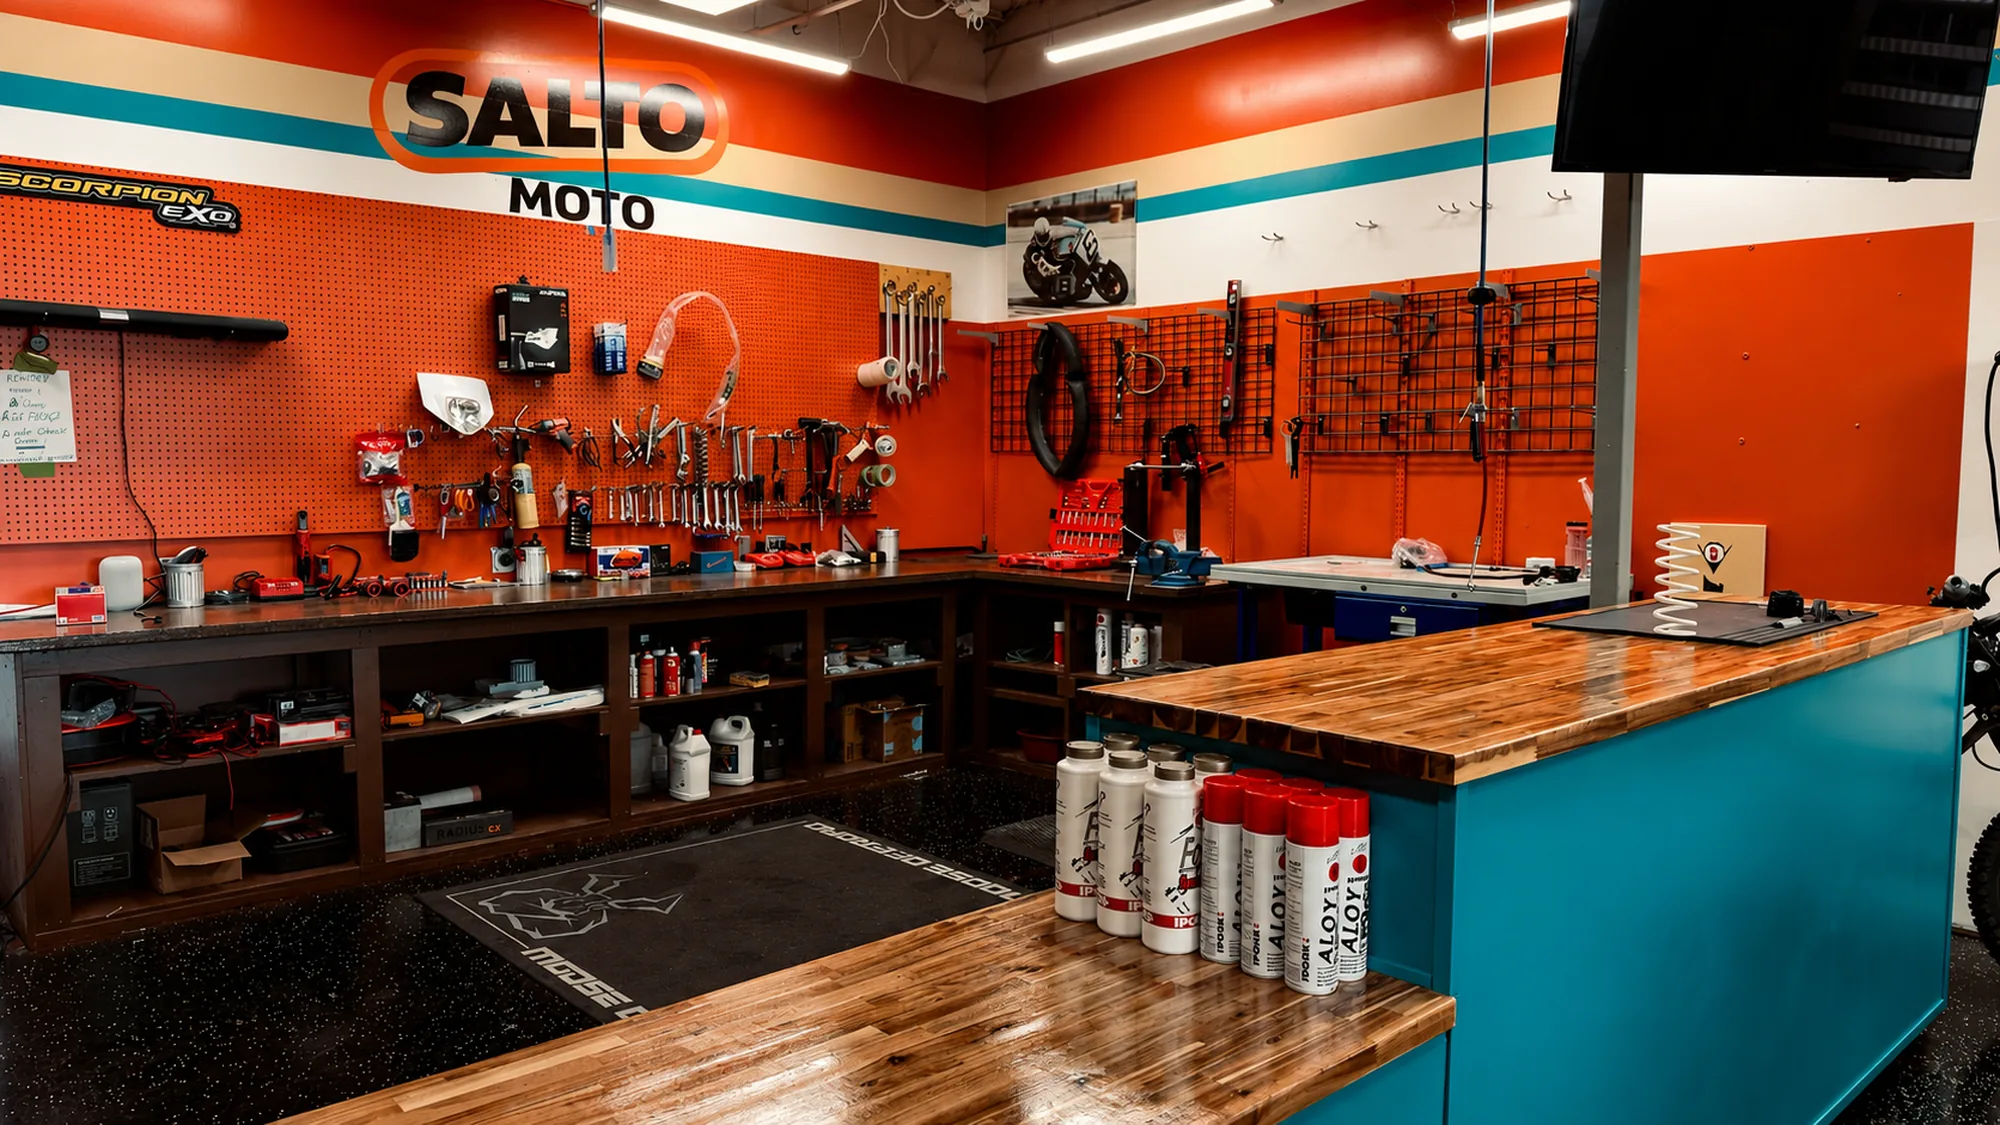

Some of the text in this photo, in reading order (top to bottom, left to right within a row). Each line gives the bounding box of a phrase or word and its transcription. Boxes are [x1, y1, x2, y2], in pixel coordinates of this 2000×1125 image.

[406, 70, 706, 153] SALTO
[0, 171, 208, 206] SCORPION
[161, 204, 234, 224] EXO
[509, 177, 655, 231] MOTO
[436, 824, 484, 840] RADIUS
[1318, 898, 1337, 965] ALOY
[1341, 887, 1362, 953] ALOY
[520, 946, 634, 1008] MOOSE
